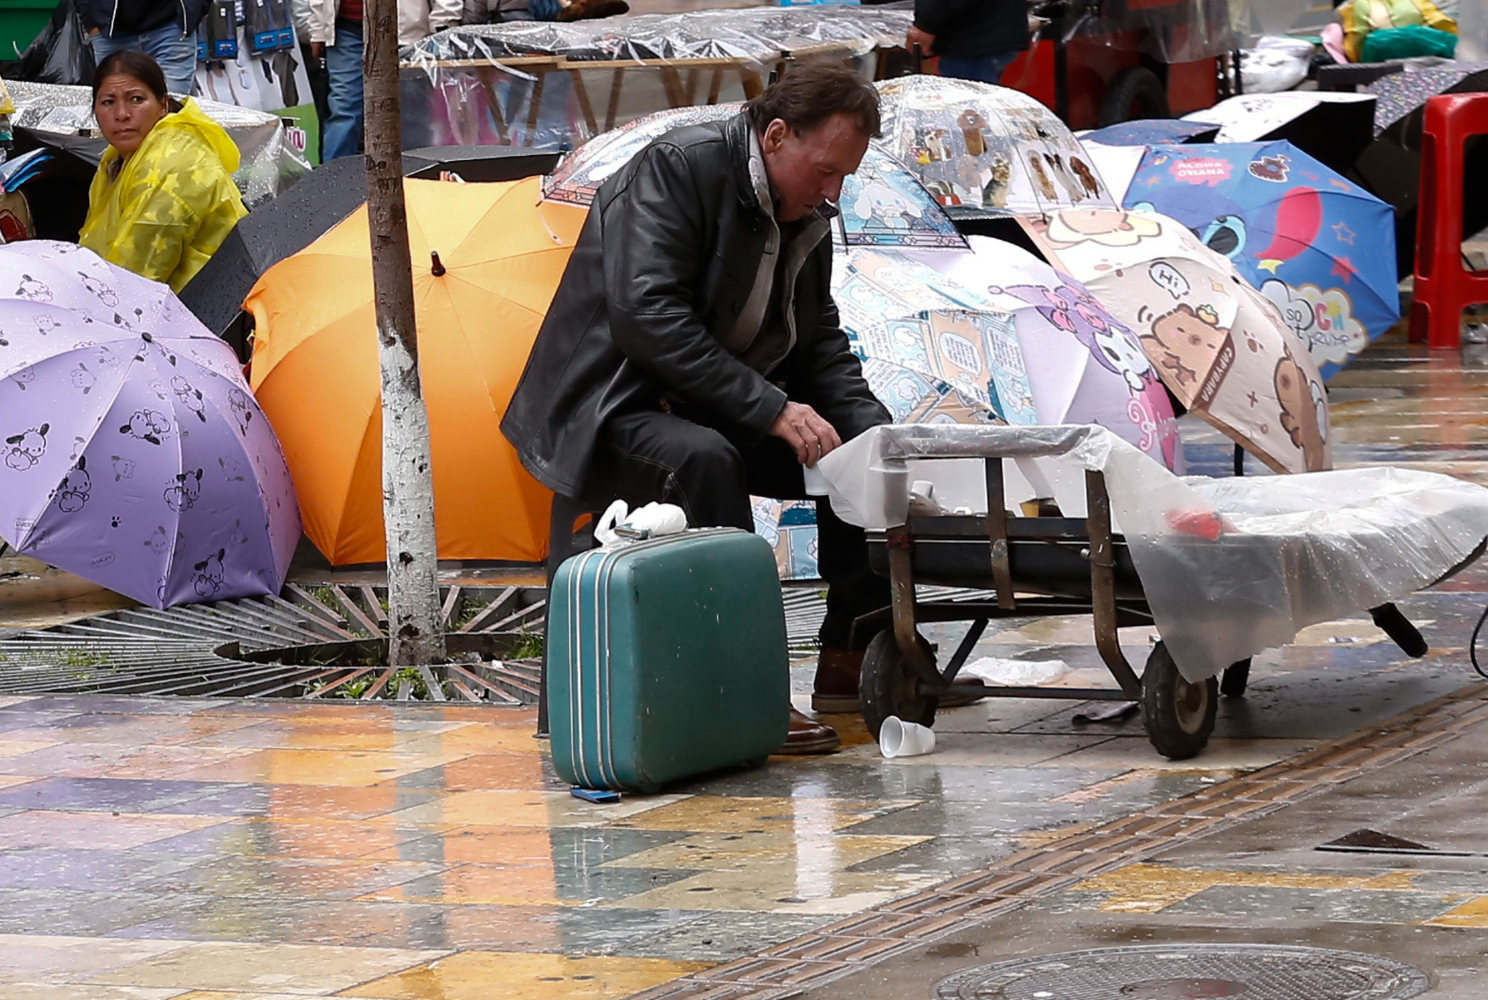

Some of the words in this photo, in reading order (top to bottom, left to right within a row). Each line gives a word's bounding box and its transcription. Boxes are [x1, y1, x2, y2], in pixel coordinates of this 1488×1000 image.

[1177, 168, 1226, 178] OHANA
[1158, 269, 1180, 289] Hi
[1201, 346, 1233, 403] CAPYBARA
